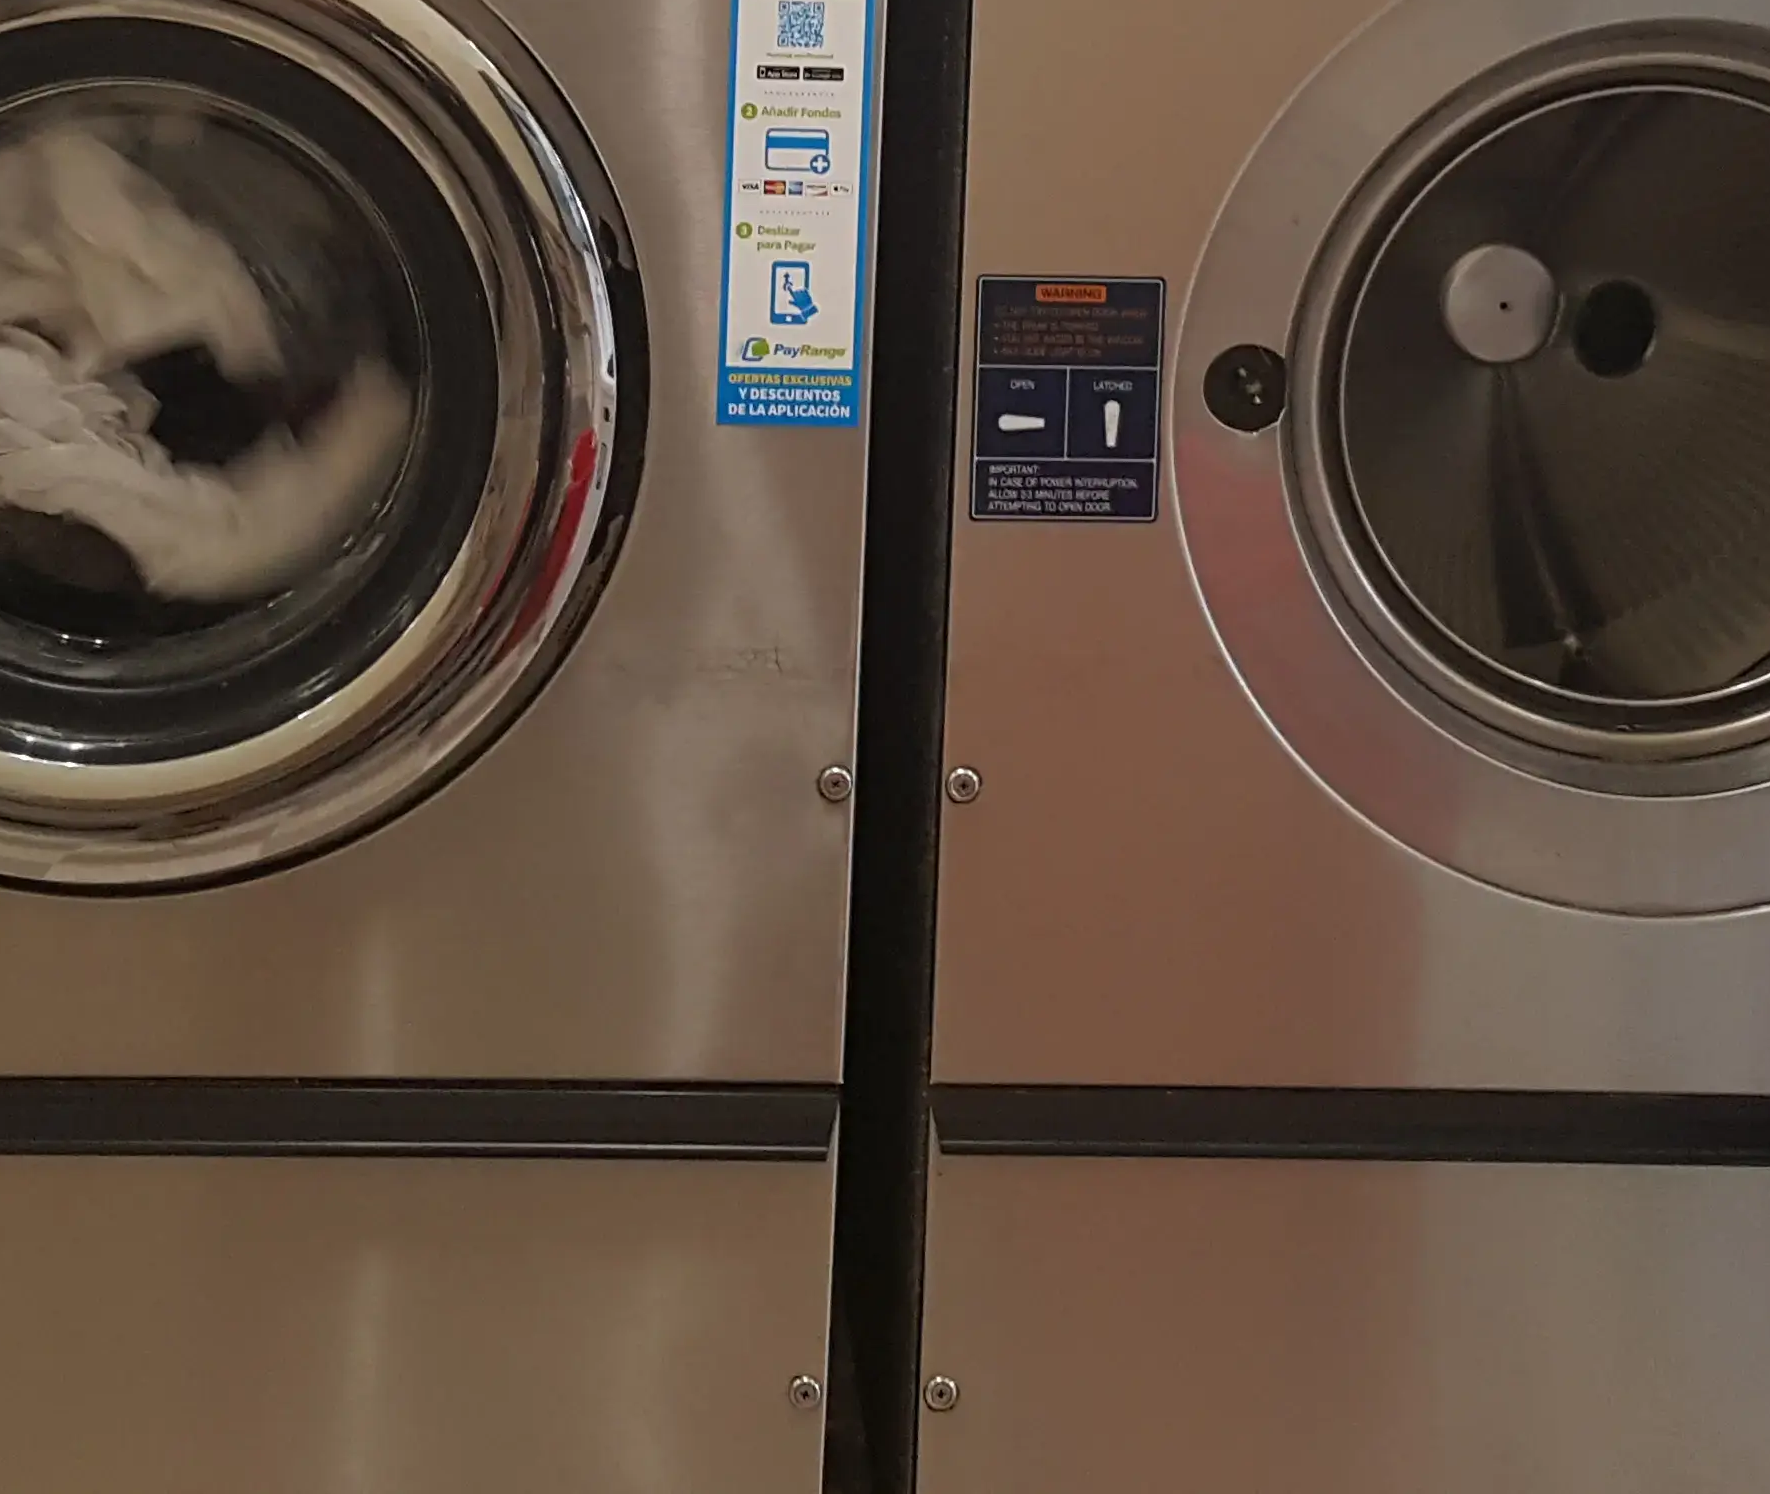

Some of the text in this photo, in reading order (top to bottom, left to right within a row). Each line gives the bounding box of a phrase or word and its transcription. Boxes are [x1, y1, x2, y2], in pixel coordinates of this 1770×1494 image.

[761, 105, 841, 119] Añadir Fondos
[757, 240, 816, 252] para Pagar
[1041, 288, 1102, 299] WARNING
[774, 343, 845, 359] PayRange
[1010, 380, 1035, 390] OPEN
[739, 387, 841, 402] Y DESCUENTOS
[729, 401, 850, 418] DE LA APLICACIÓN
